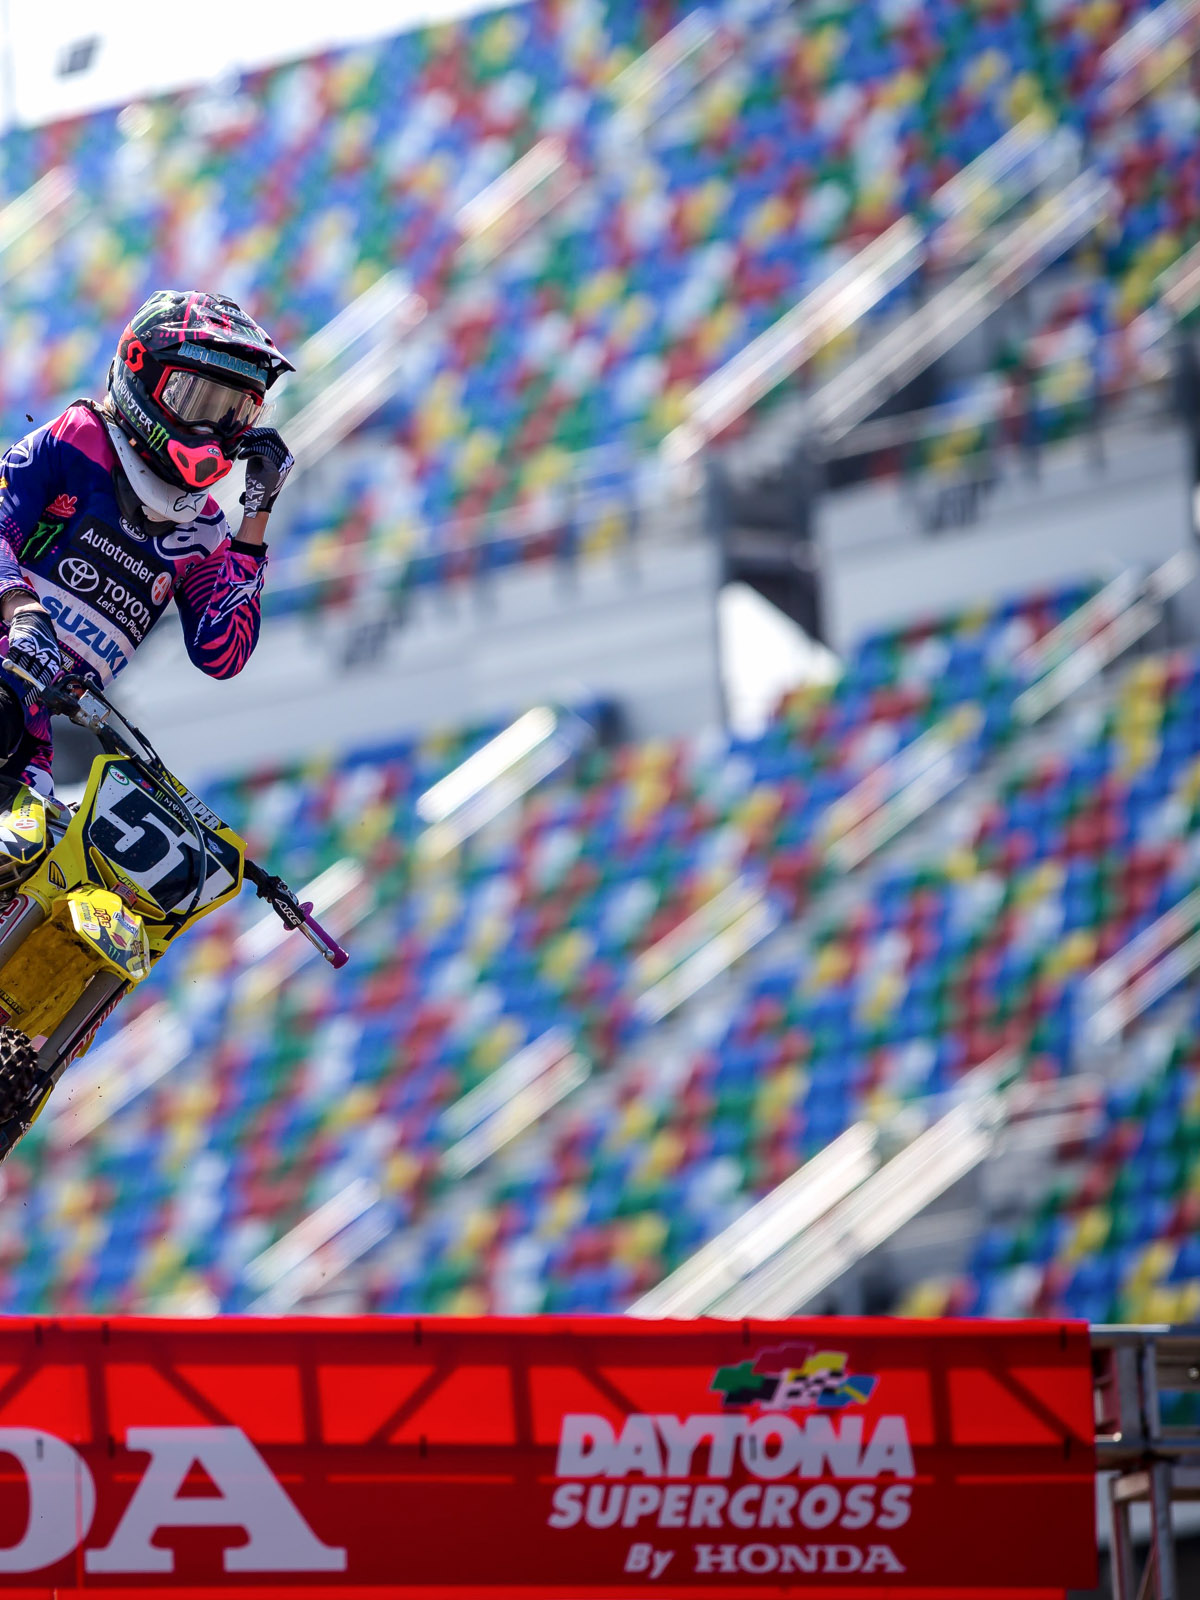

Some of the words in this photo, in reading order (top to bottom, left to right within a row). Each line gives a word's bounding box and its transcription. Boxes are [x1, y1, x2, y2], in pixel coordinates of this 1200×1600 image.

[80, 527, 155, 584] Autotrader
[96, 595, 117, 615] Let's
[115, 610, 128, 625] Go
[102, 576, 151, 632] TOYOT
[41, 595, 129, 680] SUZUKI
[274, 898, 302, 926] ARC
[555, 1413, 916, 1479] DAYTONA
[548, 1483, 912, 1530] SUPERCROSS
[624, 1542, 675, 1579] By
[694, 1544, 906, 1574] HONDA
